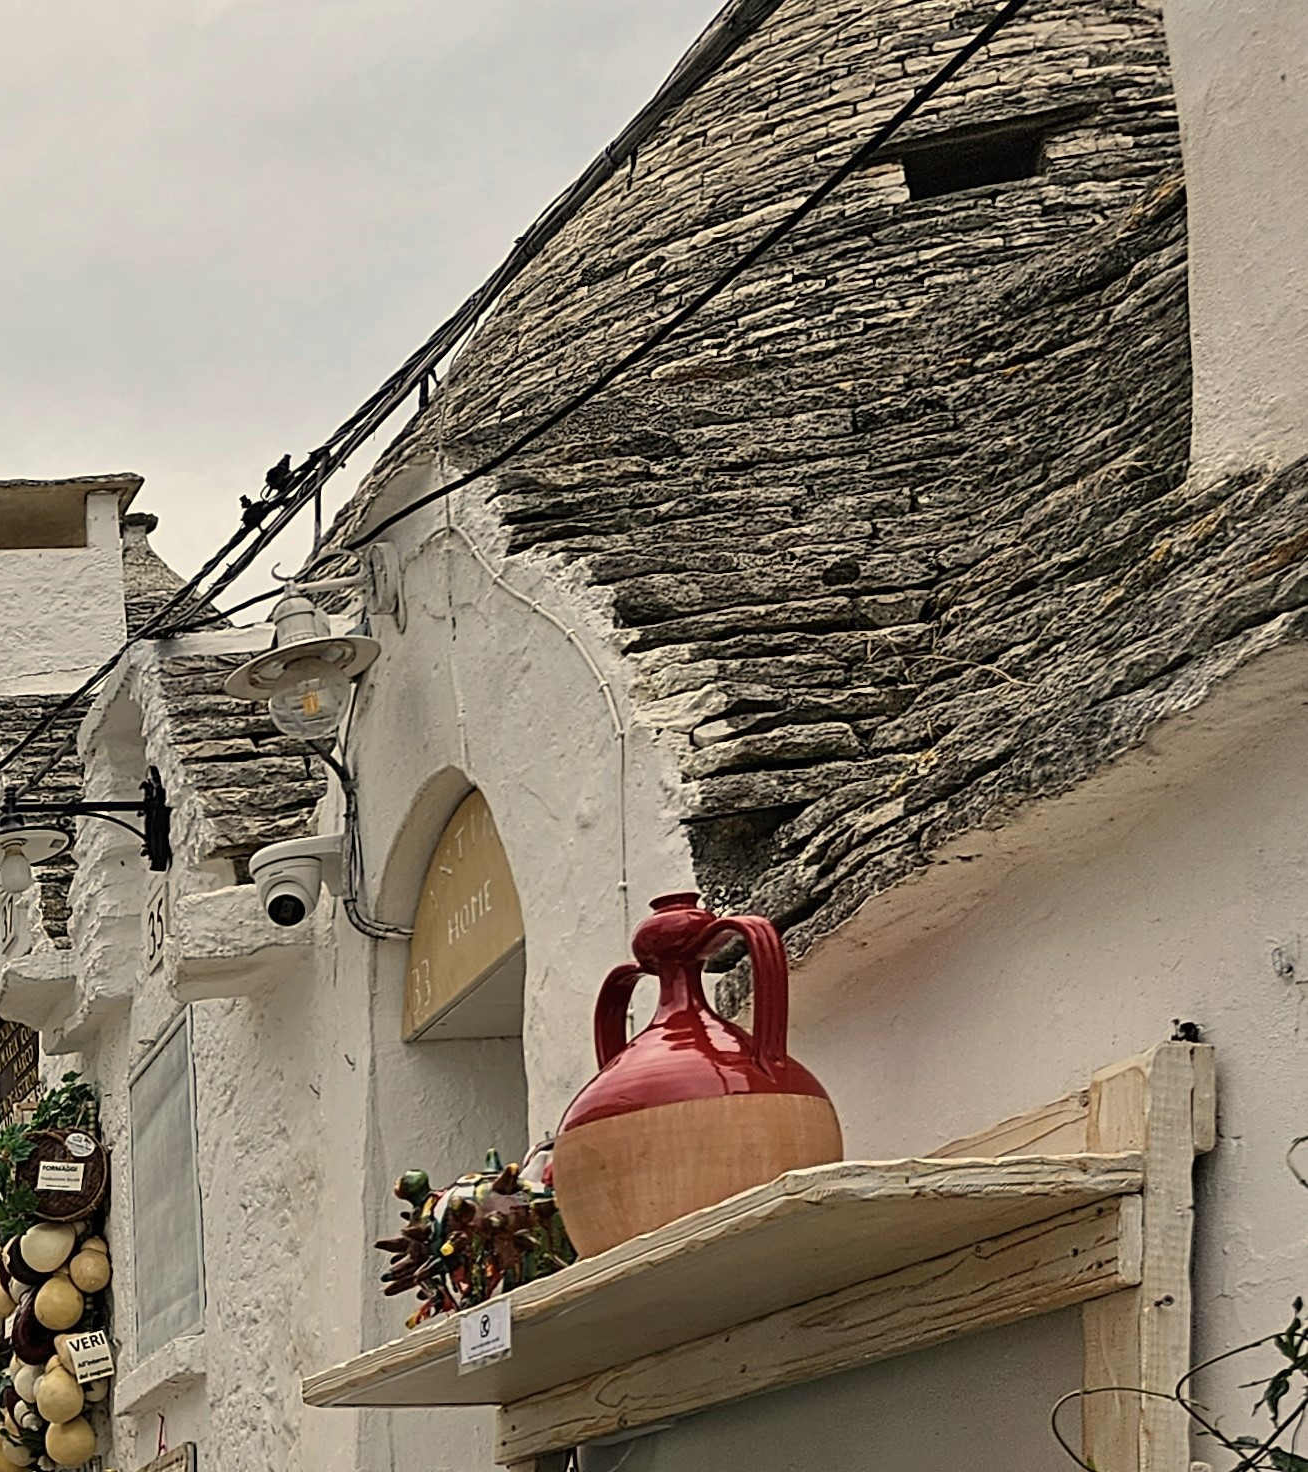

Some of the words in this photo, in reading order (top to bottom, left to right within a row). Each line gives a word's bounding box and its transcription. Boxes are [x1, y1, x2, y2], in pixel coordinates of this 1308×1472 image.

[148, 897, 164, 961] 35
[447, 879, 492, 945] HOME
[68, 1332, 106, 1352] VERI
